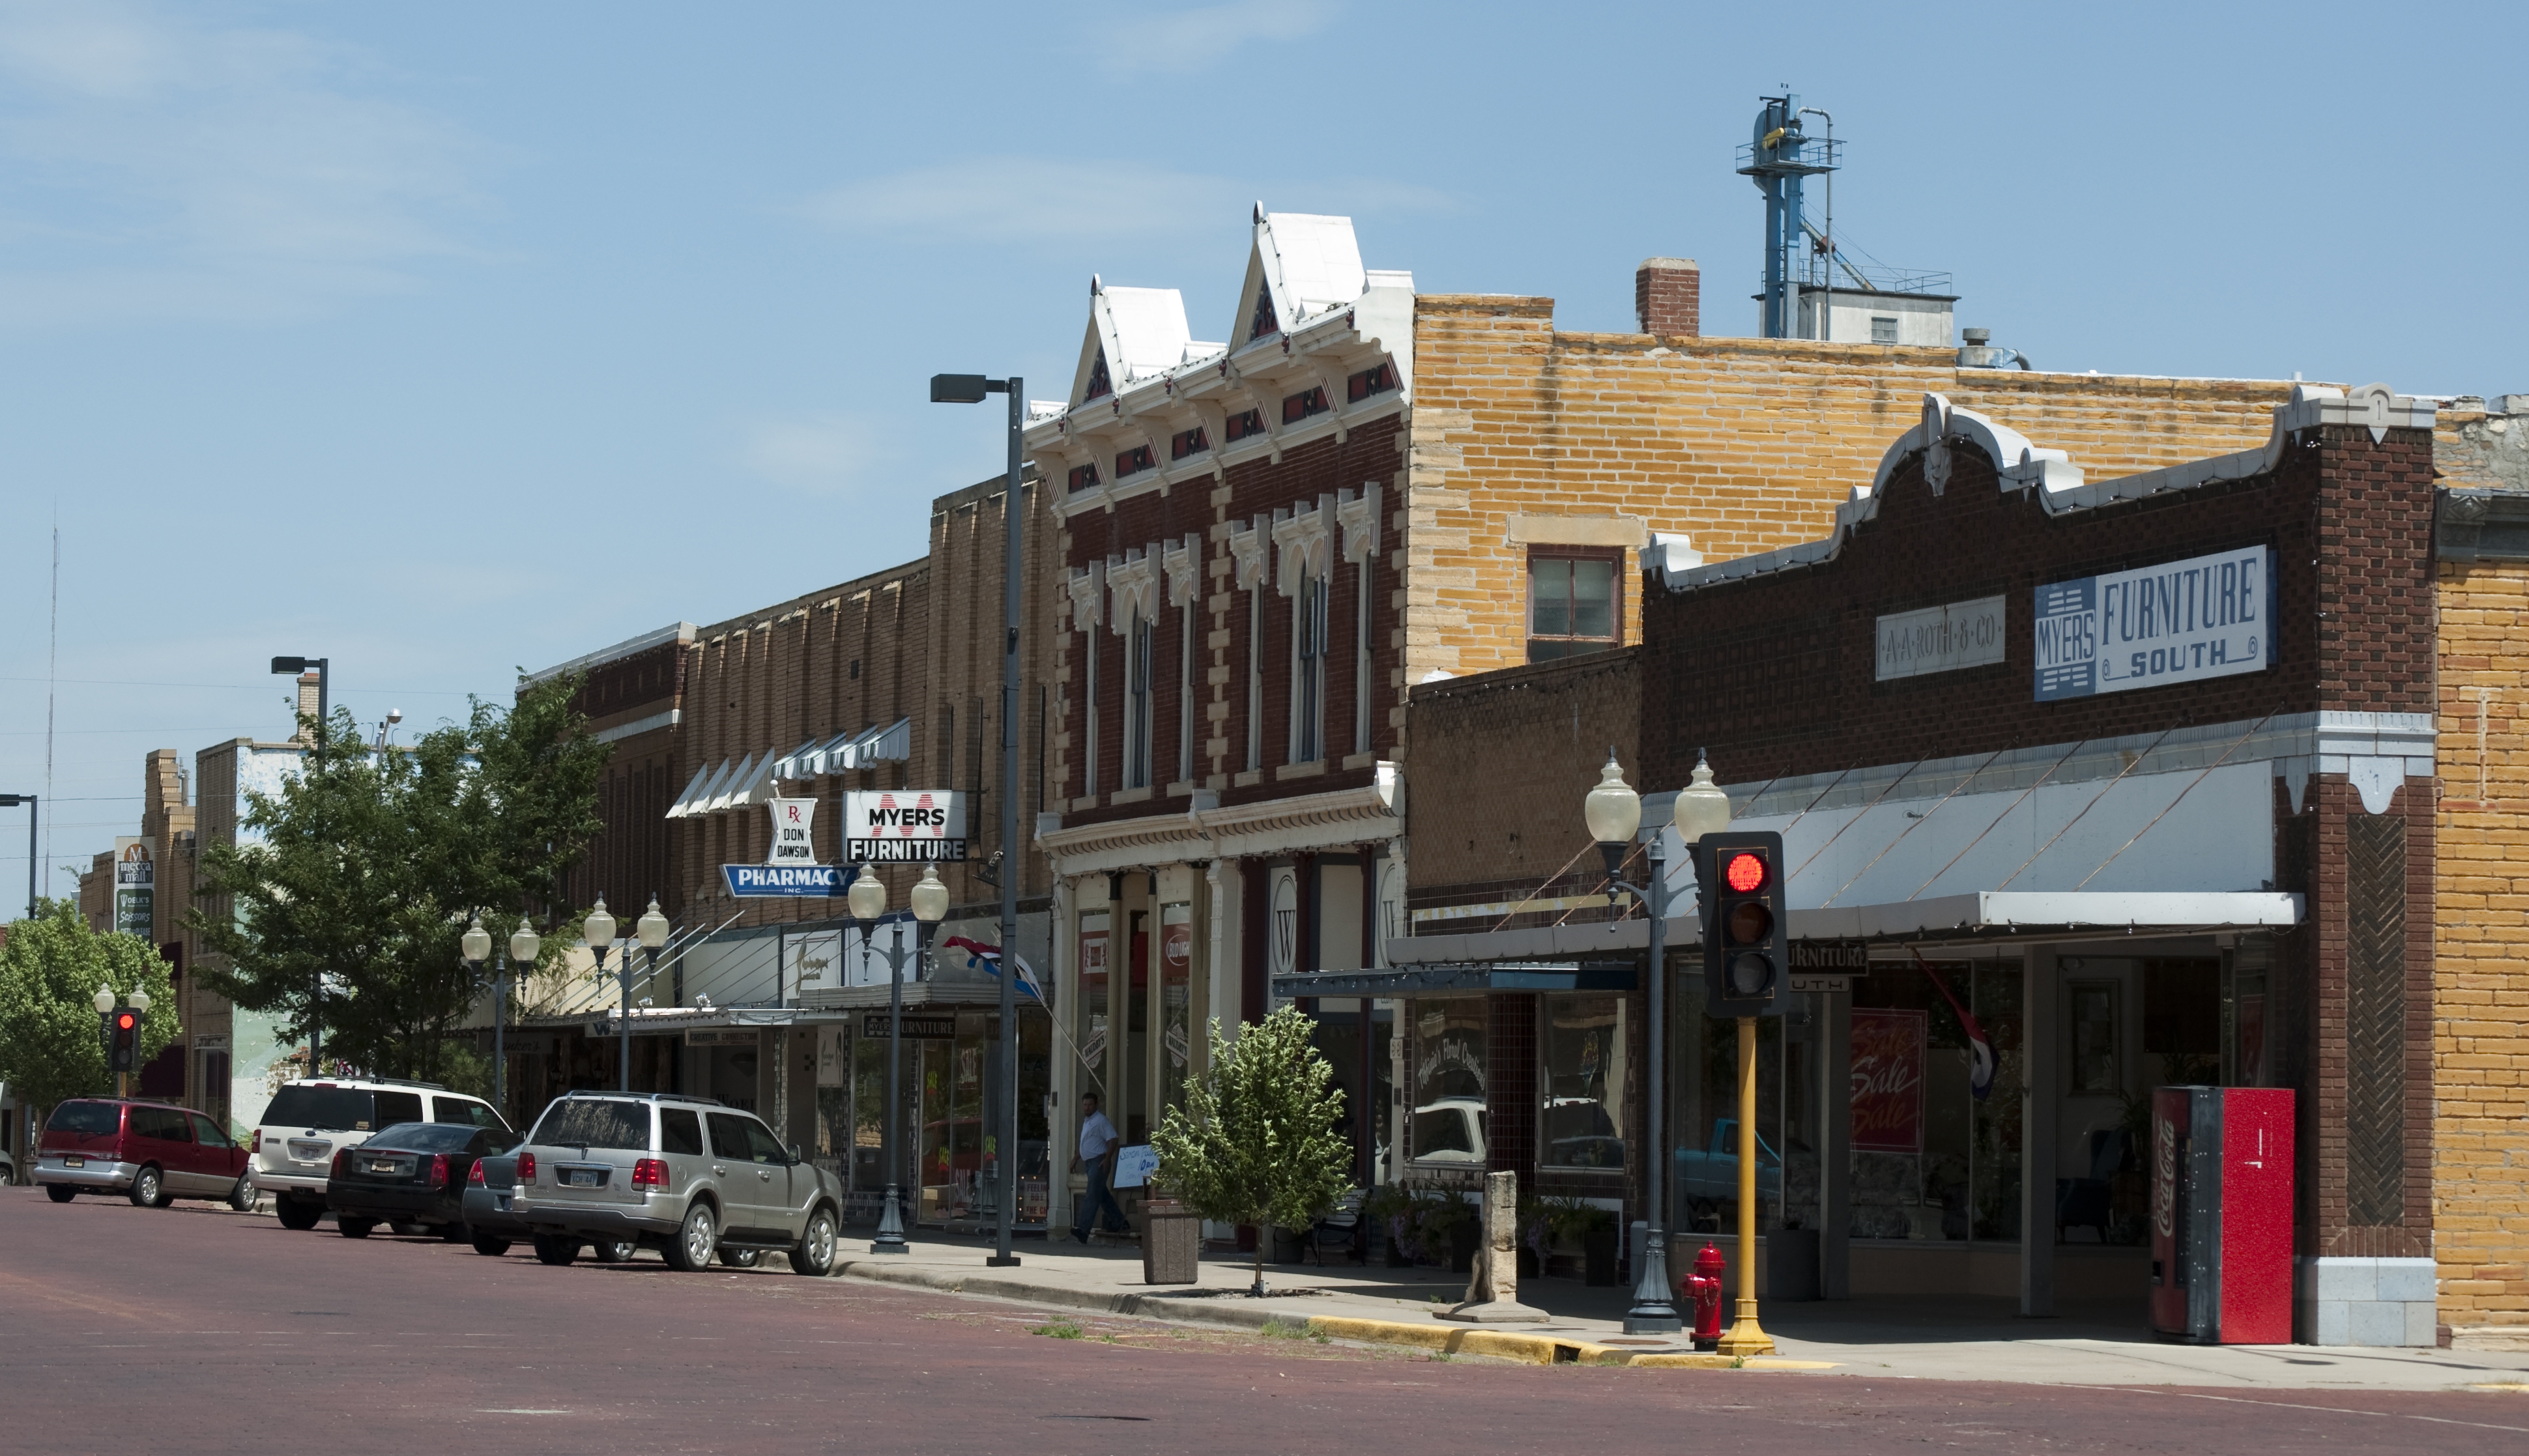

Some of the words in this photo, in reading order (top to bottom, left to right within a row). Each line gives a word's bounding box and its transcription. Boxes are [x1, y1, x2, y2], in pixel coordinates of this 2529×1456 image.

[2102, 557, 2257, 646] FURNITURE
[2036, 613, 2094, 666] MYERS
[2130, 638, 2227, 678] SOUTH
[869, 808, 945, 826] MYERS
[784, 829, 804, 841] DON
[777, 845, 809, 858] DAWSON
[850, 840, 964, 861] FURNITURE
[120, 861, 151, 872] mecca
[125, 870, 146, 883] mall
[738, 868, 850, 886] PHARMACY
[1169, 943, 1179, 958] BUD
[1179, 941, 1190, 956] LIGH
[1788, 947, 1866, 968] URNITURE
[1792, 980, 1843, 990] UTH
[690, 1033, 718, 1042] CREATIVE
[721, 1032, 758, 1040] CONNECTION
[901, 1021, 955, 1035] URNITURE
[1443, 1038, 1461, 1061] Floral
[1462, 1041, 1486, 1091] Creations
[1851, 1055, 1922, 1104] Sale
